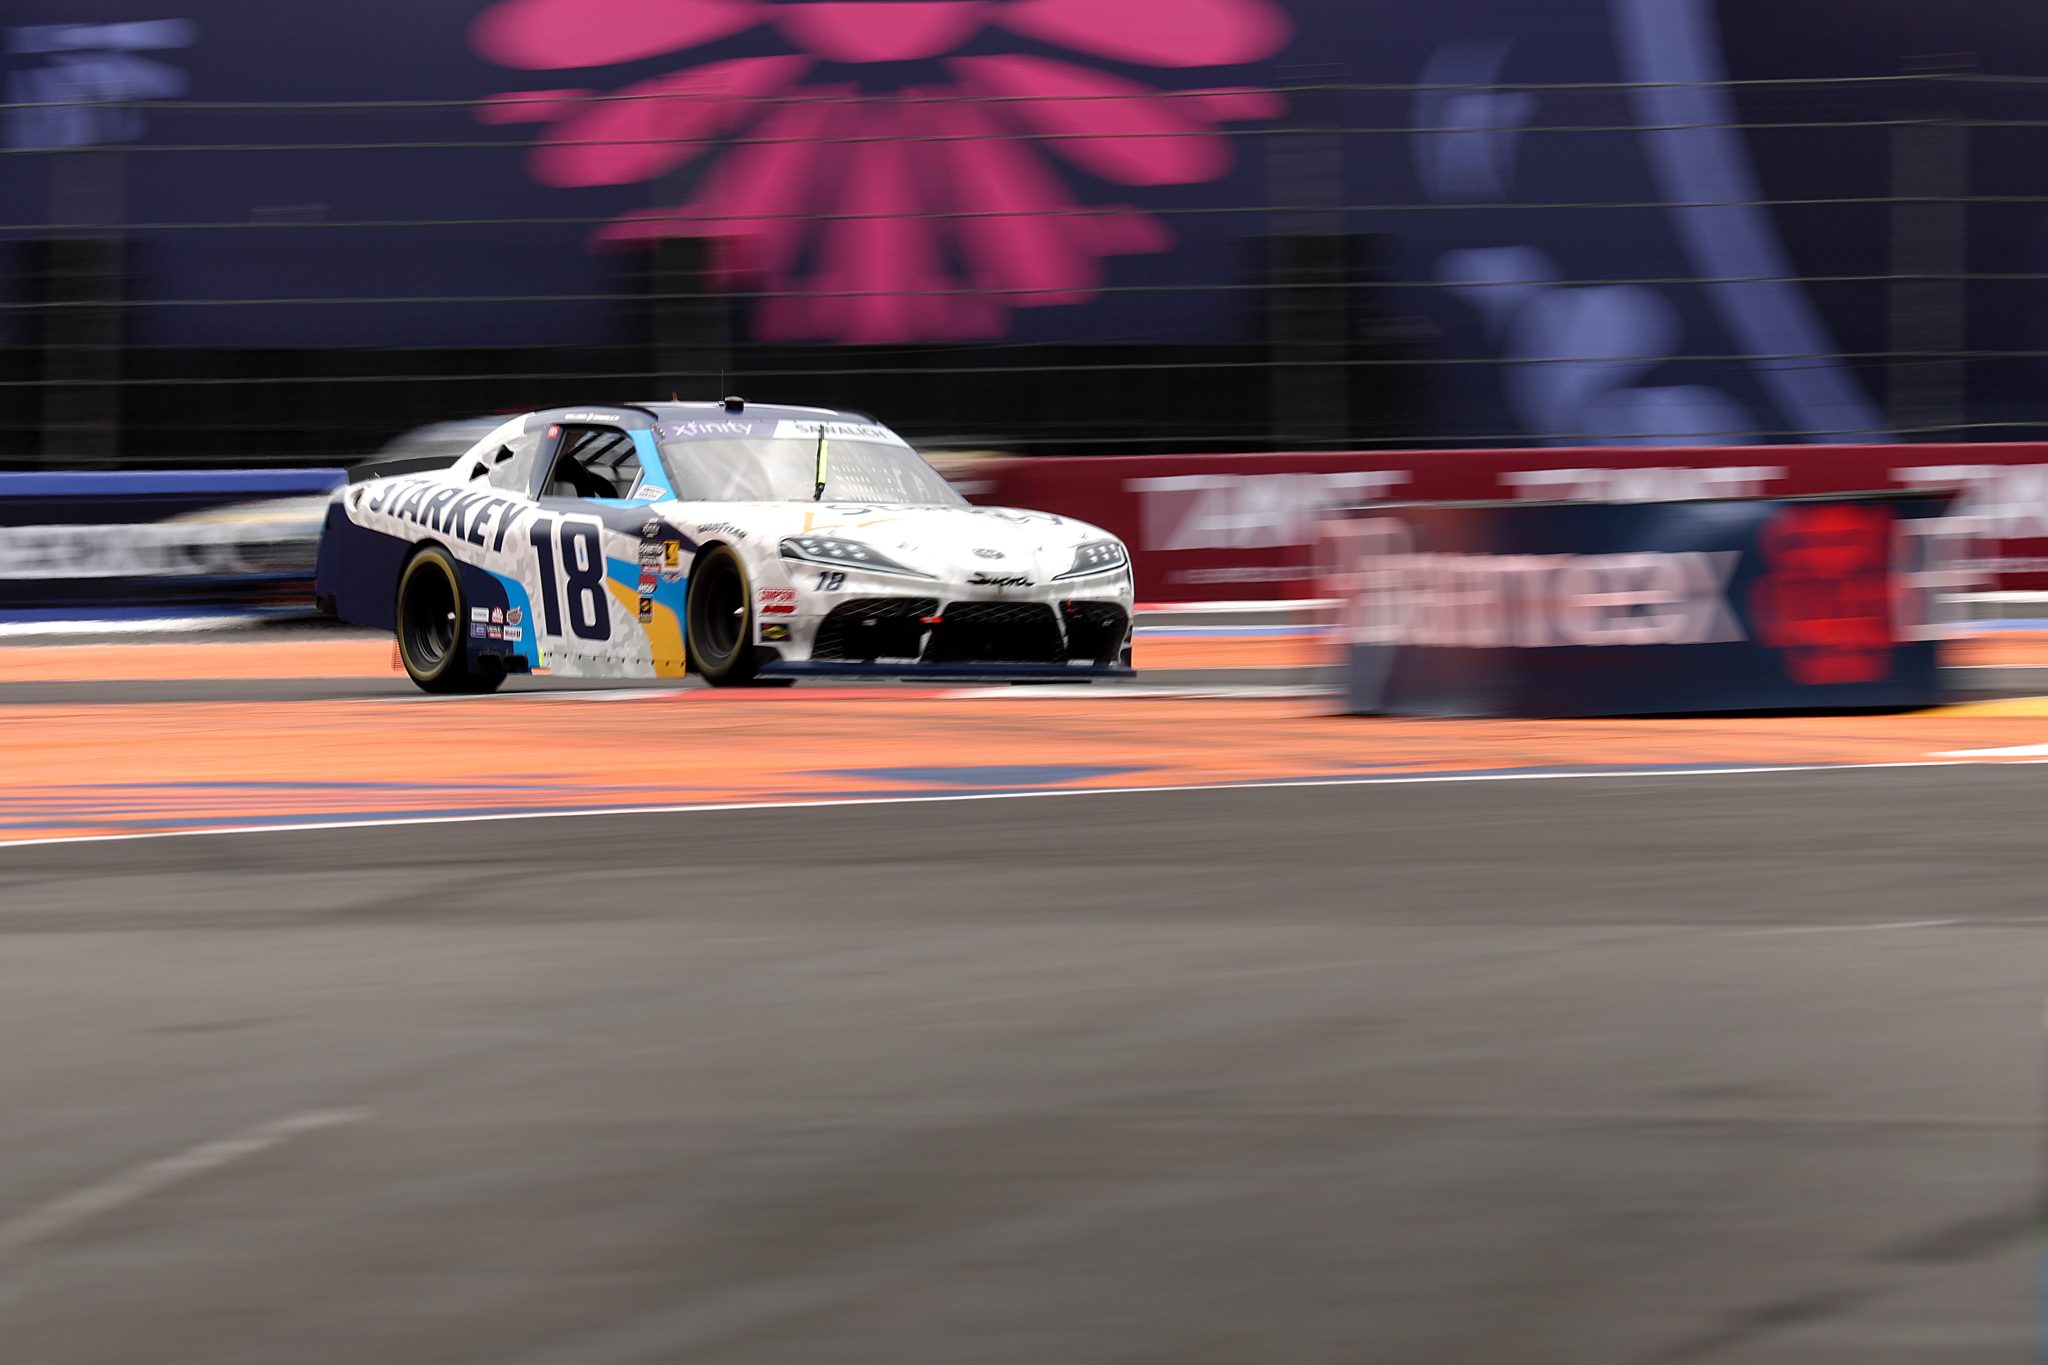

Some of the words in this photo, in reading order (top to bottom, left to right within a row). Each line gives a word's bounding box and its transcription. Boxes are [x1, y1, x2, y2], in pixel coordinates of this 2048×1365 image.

[672, 420, 752, 436] xfinity
[795, 422, 887, 439] SAWALICH
[369, 479, 529, 552] STARKEY
[530, 518, 611, 641] 18
[815, 571, 846, 591] 18
